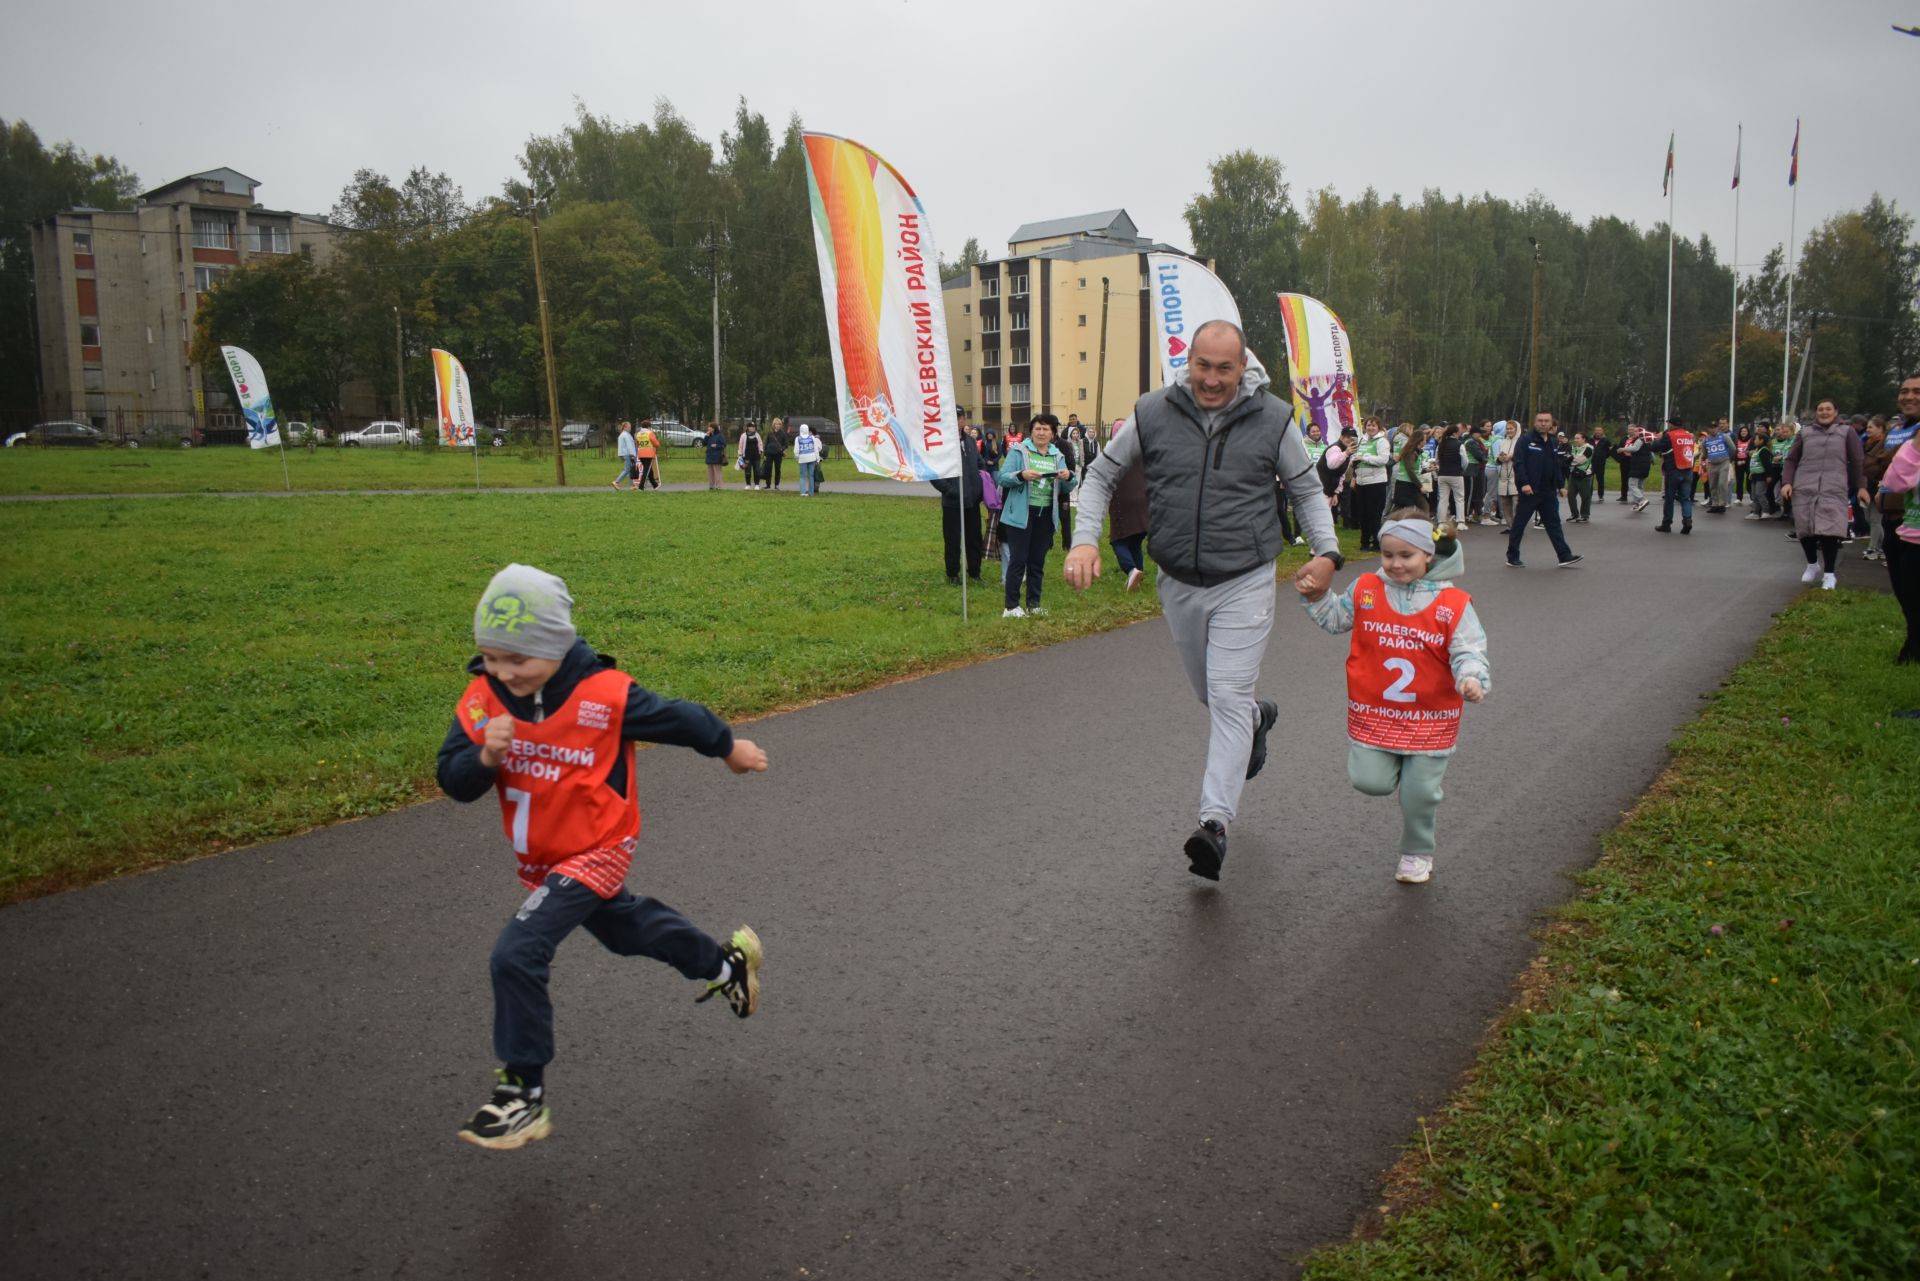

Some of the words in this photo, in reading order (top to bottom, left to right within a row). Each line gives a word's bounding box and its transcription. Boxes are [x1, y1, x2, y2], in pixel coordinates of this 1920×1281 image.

[897, 213, 928, 291] РАЙОН
[1158, 264, 1184, 335] СПОРТ!
[225, 350, 246, 384] СПОРТ!
[908, 302, 944, 452] ТУКАЕВСКИЙ
[1362, 620, 1445, 646] ТУКАЕВСКИЙ
[1378, 637, 1425, 651] РАЙОН
[1382, 656, 1417, 703] 2
[1347, 700, 1371, 715] ПОРТ
[1378, 706, 1421, 721] НОРМА
[1421, 708, 1461, 721] ЖИЗНИ
[510, 738, 596, 767] ЕВСКИЙ
[505, 787, 532, 855] 7
